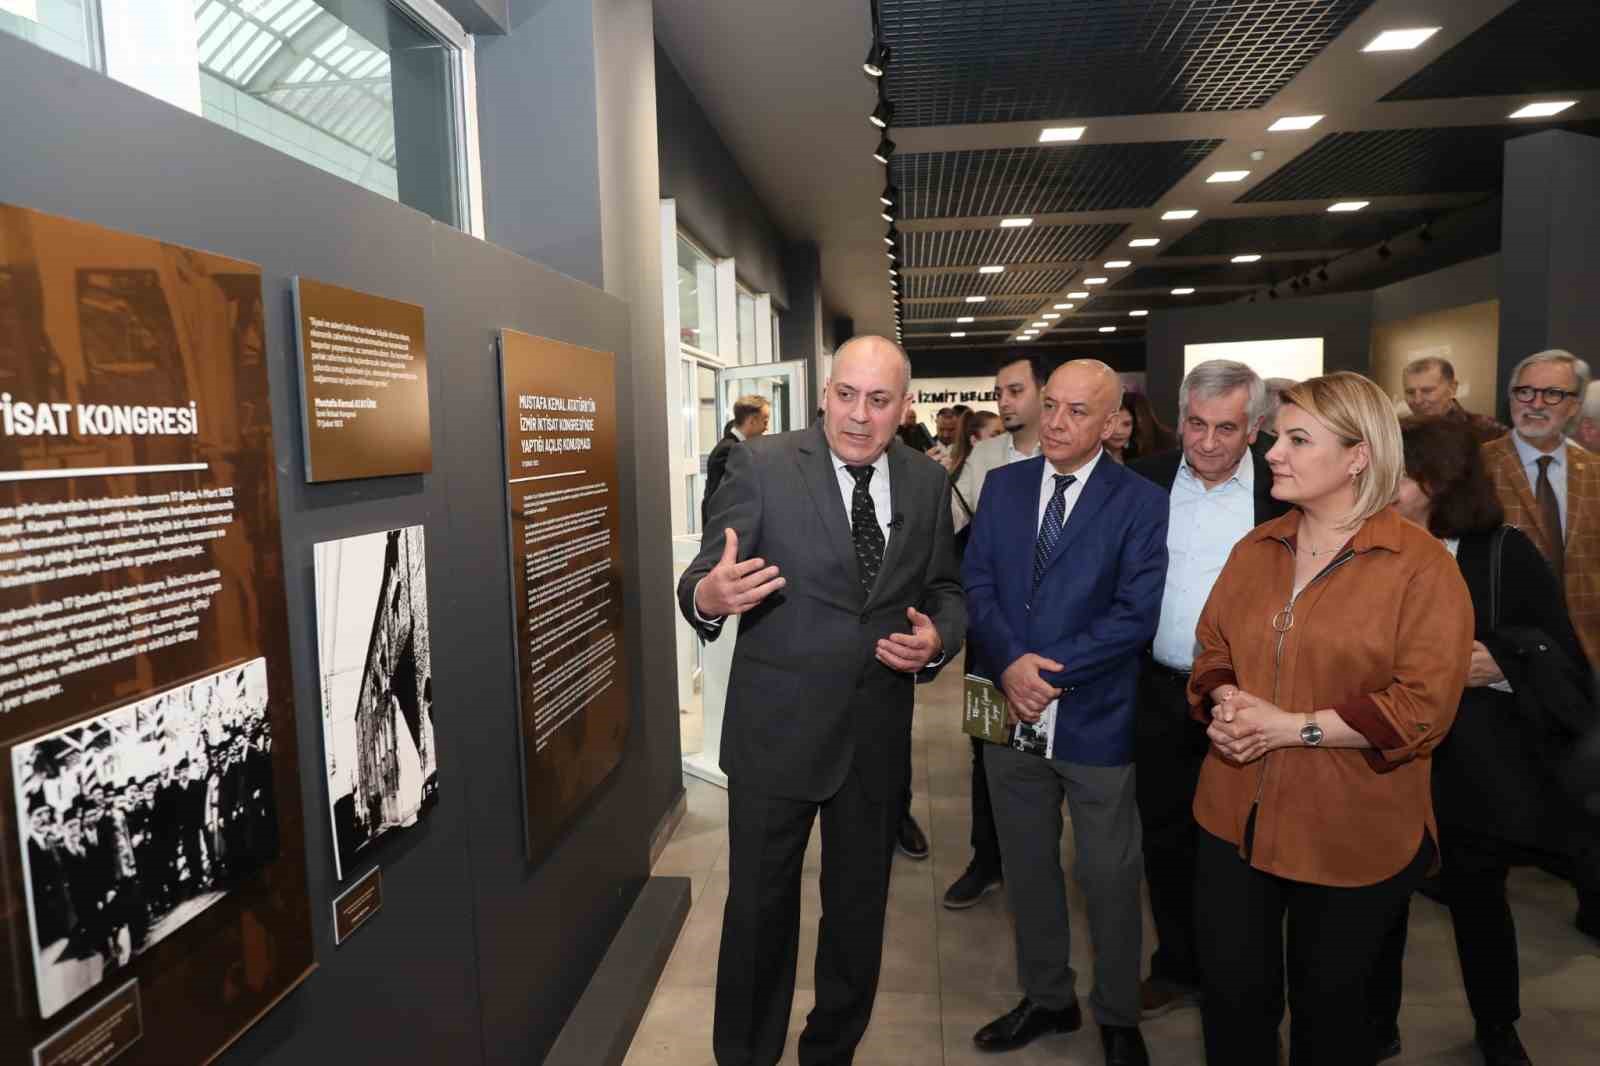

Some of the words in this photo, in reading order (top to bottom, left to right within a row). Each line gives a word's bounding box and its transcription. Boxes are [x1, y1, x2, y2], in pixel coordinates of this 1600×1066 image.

[519, 395, 547, 411] MUSTAFA
[918, 389, 957, 403] İZMİT
[0, 392, 72, 435] İSAT
[76, 401, 198, 435] KONGRESİ
